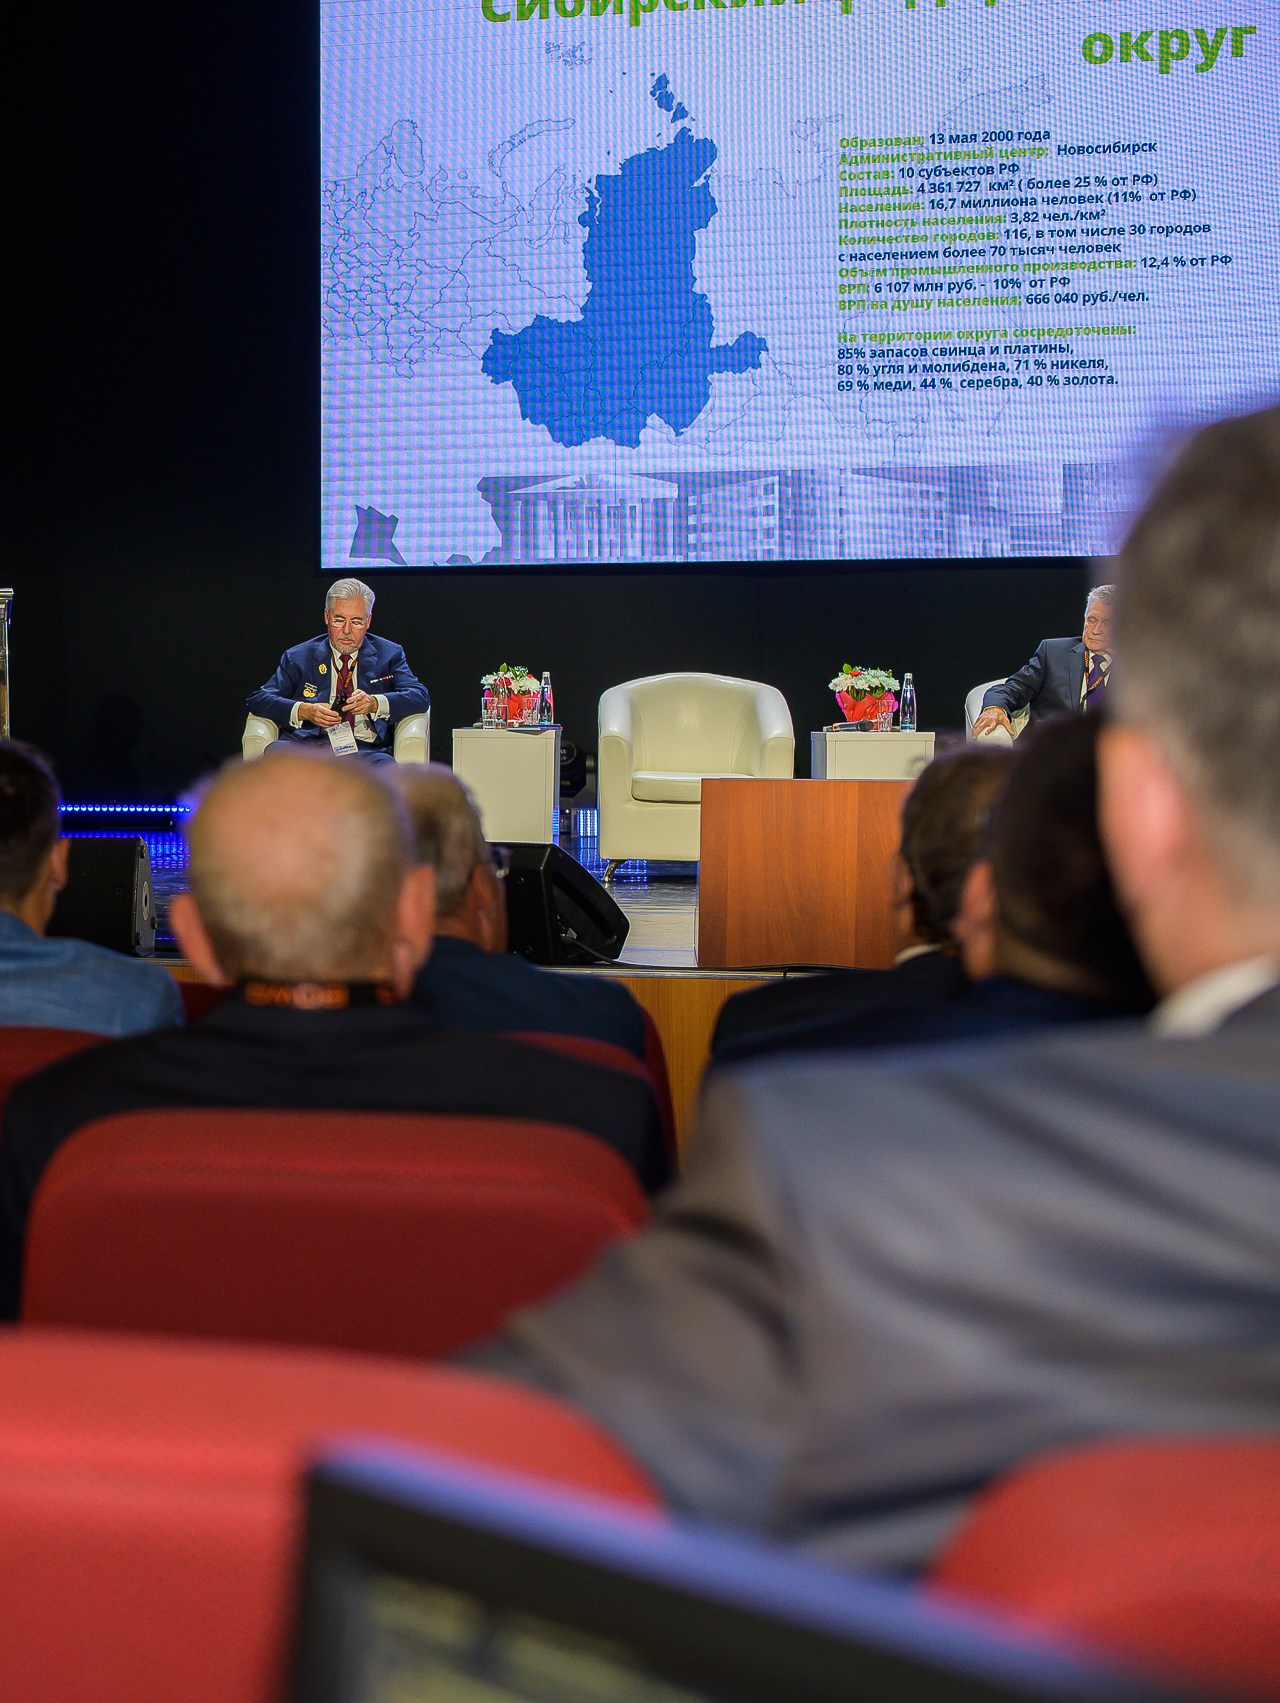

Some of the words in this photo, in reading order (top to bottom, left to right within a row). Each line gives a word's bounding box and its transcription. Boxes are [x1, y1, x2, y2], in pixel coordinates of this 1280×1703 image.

[1081, 25, 1257, 75] округ
[839, 136, 924, 150] Образован:
[929, 133, 945, 144] 13
[948, 133, 977, 144] мая
[981, 130, 1013, 142] 2000
[1018, 130, 1050, 142] года
[839, 147, 994, 166] Административный
[999, 147, 1050, 161] центр:
[1057, 141, 1158, 156] Новосибирск
[839, 168, 895, 181] Состав:
[899, 167, 915, 178] 10
[918, 165, 995, 180] субъектов
[999, 163, 1019, 174] РФ
[839, 185, 913, 197] Площадь:
[916, 183, 925, 194] 4
[929, 182, 952, 193] 361
[956, 180, 981, 192] 727
[988, 179, 1014, 191] км²
[1027, 178, 1070, 190] более
[1074, 176, 1090, 187] 25
[1095, 175, 1107, 187] %
[1111, 177, 1128, 186] от
[1132, 174, 1157, 187] РФ)
[838, 201, 925, 213] Население:
[928, 198, 956, 211] 16,7
[960, 196, 1037, 208] миллиона
[1042, 193, 1104, 205] человек
[1108, 190, 1142, 205] (11%
[1149, 191, 1166, 201] от
[1170, 189, 1196, 201] РФ)
[838, 218, 918, 229] Плотность
[922, 215, 1006, 226] населения:
[1011, 212, 1039, 224] 3,82
[1043, 209, 1105, 222] чел./км²
[838, 234, 928, 245] Количество
[933, 231, 1000, 245] городов:
[1004, 228, 1031, 241] 116,
[1036, 229, 1044, 238] в
[1048, 228, 1077, 238] том
[1081, 226, 1125, 237] числе
[1129, 224, 1146, 234] 30
[1150, 223, 1211, 237] городов
[838, 252, 845, 262] с
[849, 249, 938, 261] населением
[942, 246, 986, 258] более
[990, 245, 1006, 257] 70
[1010, 245, 1055, 256] тысяч
[1058, 242, 1121, 254] человек
[838, 267, 887, 279] Объём
[891, 262, 1019, 279] промышленного
[1023, 259, 1137, 275] производства:
[1140, 257, 1169, 270] 12,4
[1173, 256, 1186, 267] %
[1189, 256, 1206, 267] от
[1211, 254, 1233, 266] РФ
[838, 283, 870, 295] ВРП:
[874, 282, 882, 293] 6
[886, 281, 910, 293] 107
[913, 281, 944, 292] млн
[947, 279, 977, 294] руб.
[993, 278, 1022, 290] 10%
[1029, 278, 1045, 288] от
[1050, 276, 1071, 288] РФ
[838, 299, 867, 311] ВРП
[870, 301, 888, 310] на
[891, 298, 933, 311] душу
[937, 295, 1022, 307] населения:
[1026, 293, 1050, 304] 666
[1054, 292, 1078, 303] 040
[1082, 290, 1149, 306] руб./чел.
[837, 332, 857, 344] На
[861, 330, 953, 344] территории
[956, 328, 1008, 342] округа
[1013, 325, 1137, 341] сосредоточены:
[837, 347, 866, 359] 85%
[869, 347, 928, 359] запасов
[931, 346, 986, 358] свинца
[990, 346, 1000, 355] и
[1004, 343, 1074, 355] платины,
[837, 364, 853, 375] 80
[856, 363, 870, 375] %
[873, 363, 904, 377] угля
[908, 363, 918, 373] и
[922, 360, 1010, 373] молибдена,
[1014, 359, 1029, 370] 71
[1034, 359, 1047, 370] %
[1050, 358, 1109, 370] никеля,
[837, 380, 853, 391] 69
[856, 379, 870, 391] %
[873, 380, 916, 392] меди,
[919, 378, 936, 389] 44
[939, 377, 953, 389] %
[959, 376, 1023, 390] серебра,
[1026, 375, 1043, 386] 40
[1046, 375, 1060, 386] %
[1063, 374, 1119, 386] золота.
